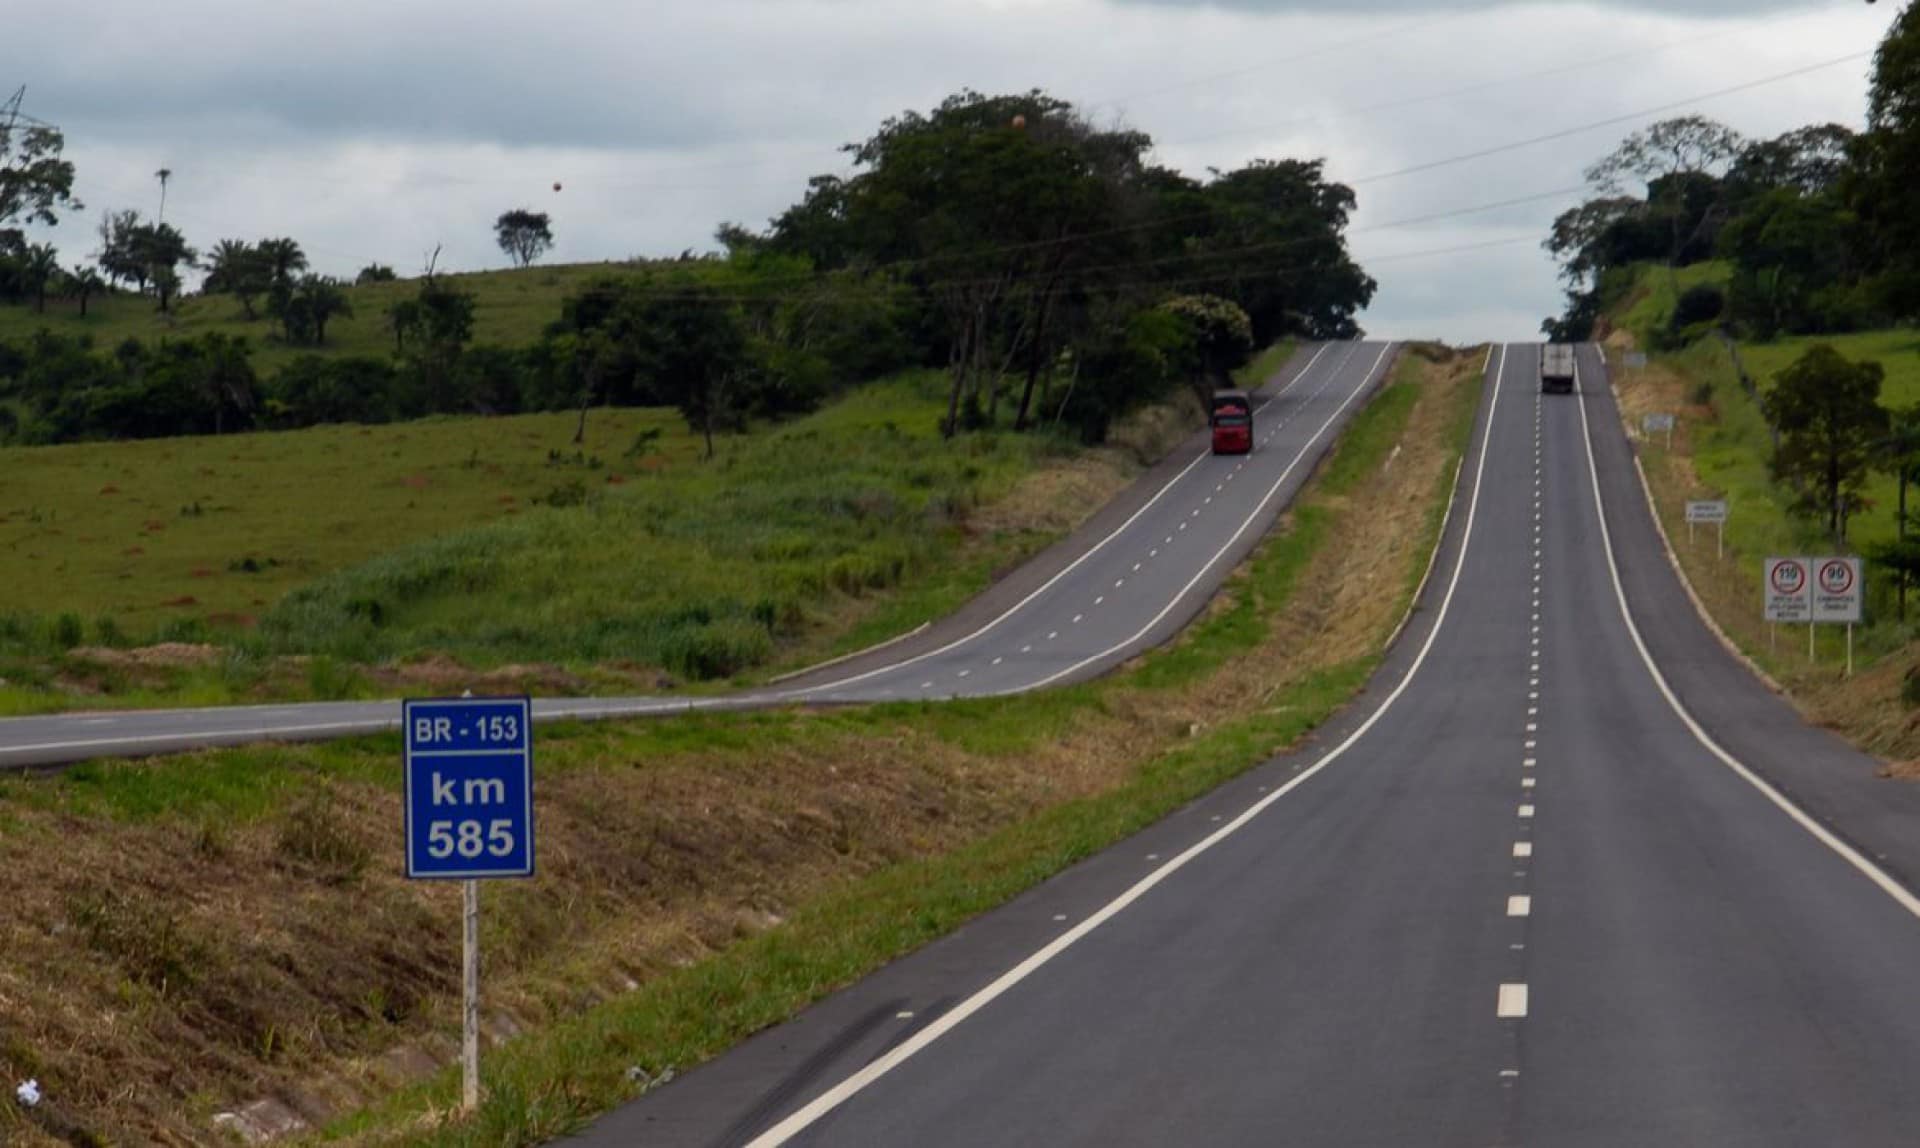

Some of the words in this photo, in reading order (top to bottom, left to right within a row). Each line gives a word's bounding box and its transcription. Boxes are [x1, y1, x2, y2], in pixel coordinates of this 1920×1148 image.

[1827, 567, 1844, 579] 90
[415, 717, 452, 742] BR
[475, 715, 518, 741] 153
[432, 771, 505, 805] km
[428, 819, 514, 858] 585
